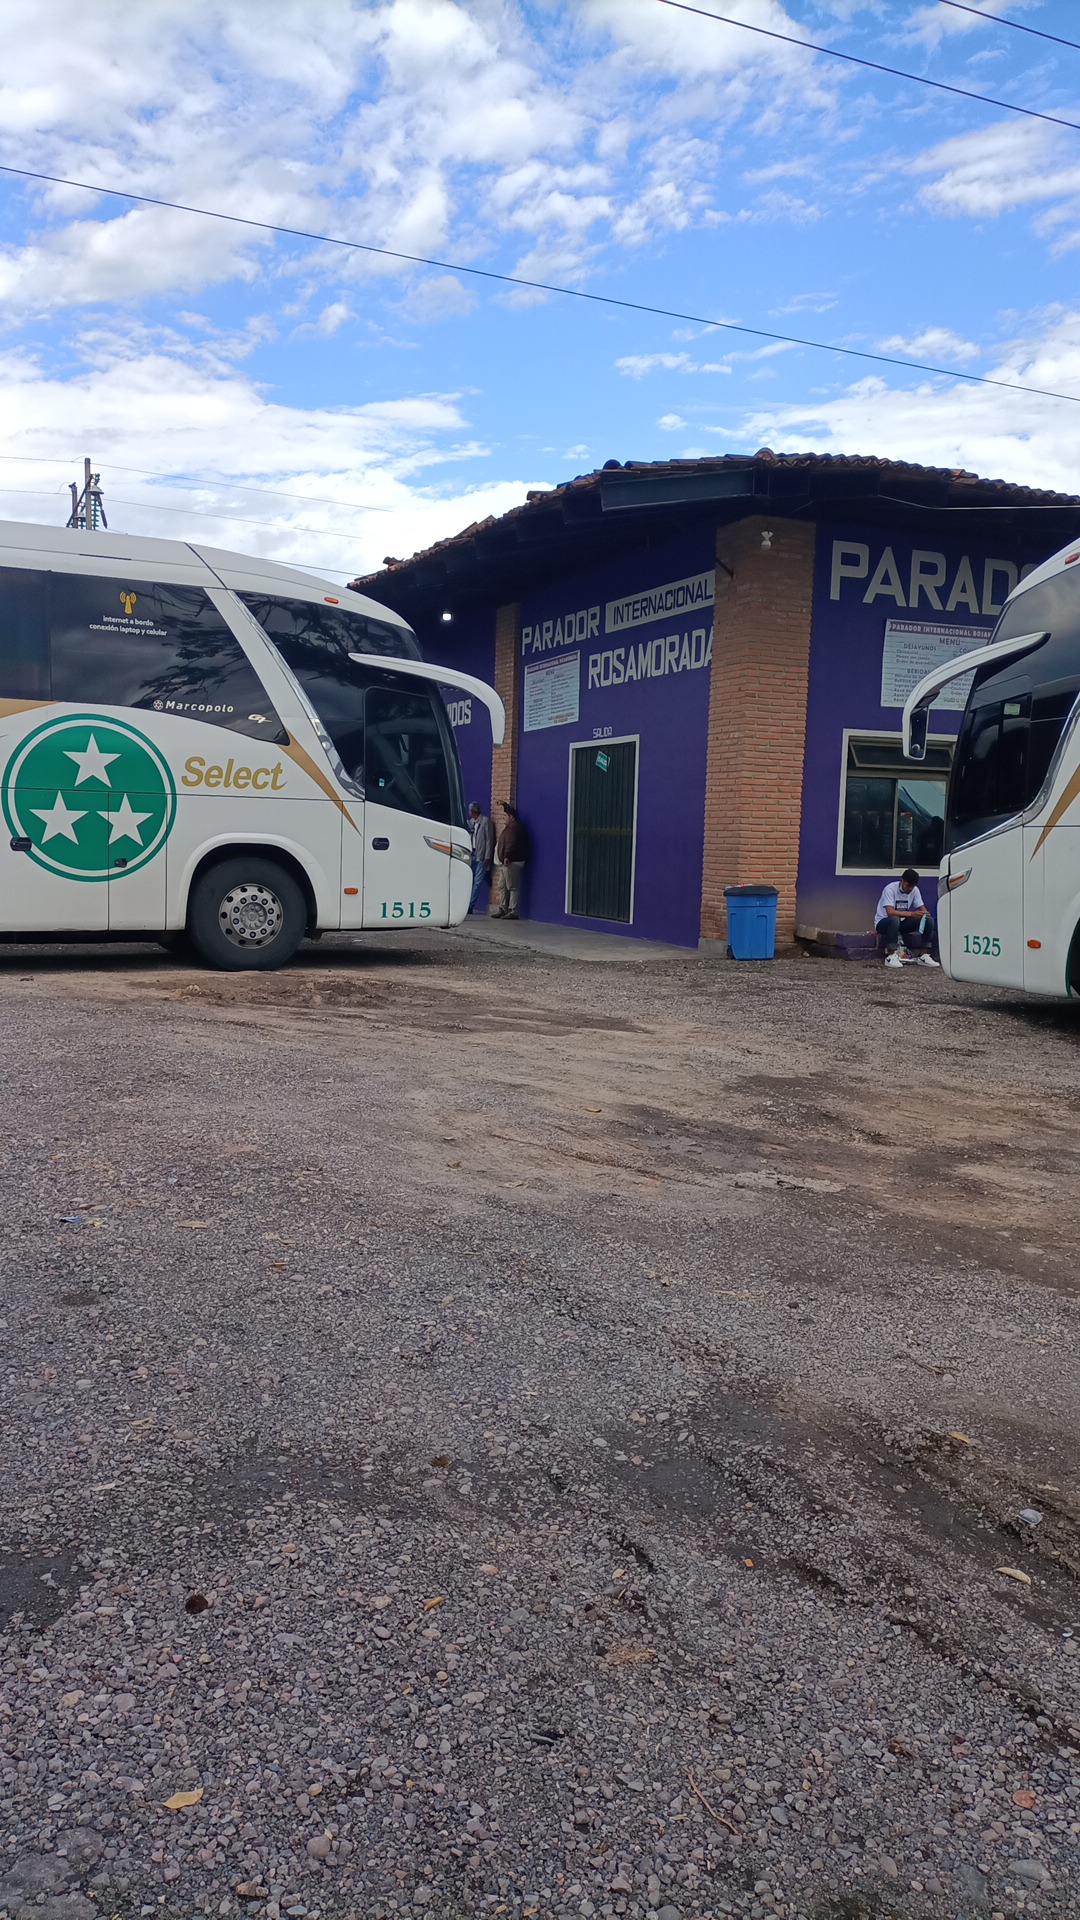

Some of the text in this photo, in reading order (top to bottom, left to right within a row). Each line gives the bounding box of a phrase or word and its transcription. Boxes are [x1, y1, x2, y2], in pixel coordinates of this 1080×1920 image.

[135, 618, 154, 627] bordo
[521, 579, 714, 656] PARADOR INTERNACIONAL
[120, 626, 140, 635] laptop
[146, 629, 168, 637] celular
[892, 623, 922, 633] PARADOR
[923, 626, 971, 637] INTERNACIONAL
[903, 643, 937, 652] DESAYUNOS
[939, 637, 961, 646] MENÚ
[588, 625, 714, 690] ROSAMORADA
[165, 700, 234, 713] Marcopolo
[592, 726, 613, 739] SALIDA
[181, 756, 288, 791] Select
[380, 901, 432, 919] 1515
[963, 934, 1002, 957] 1525
